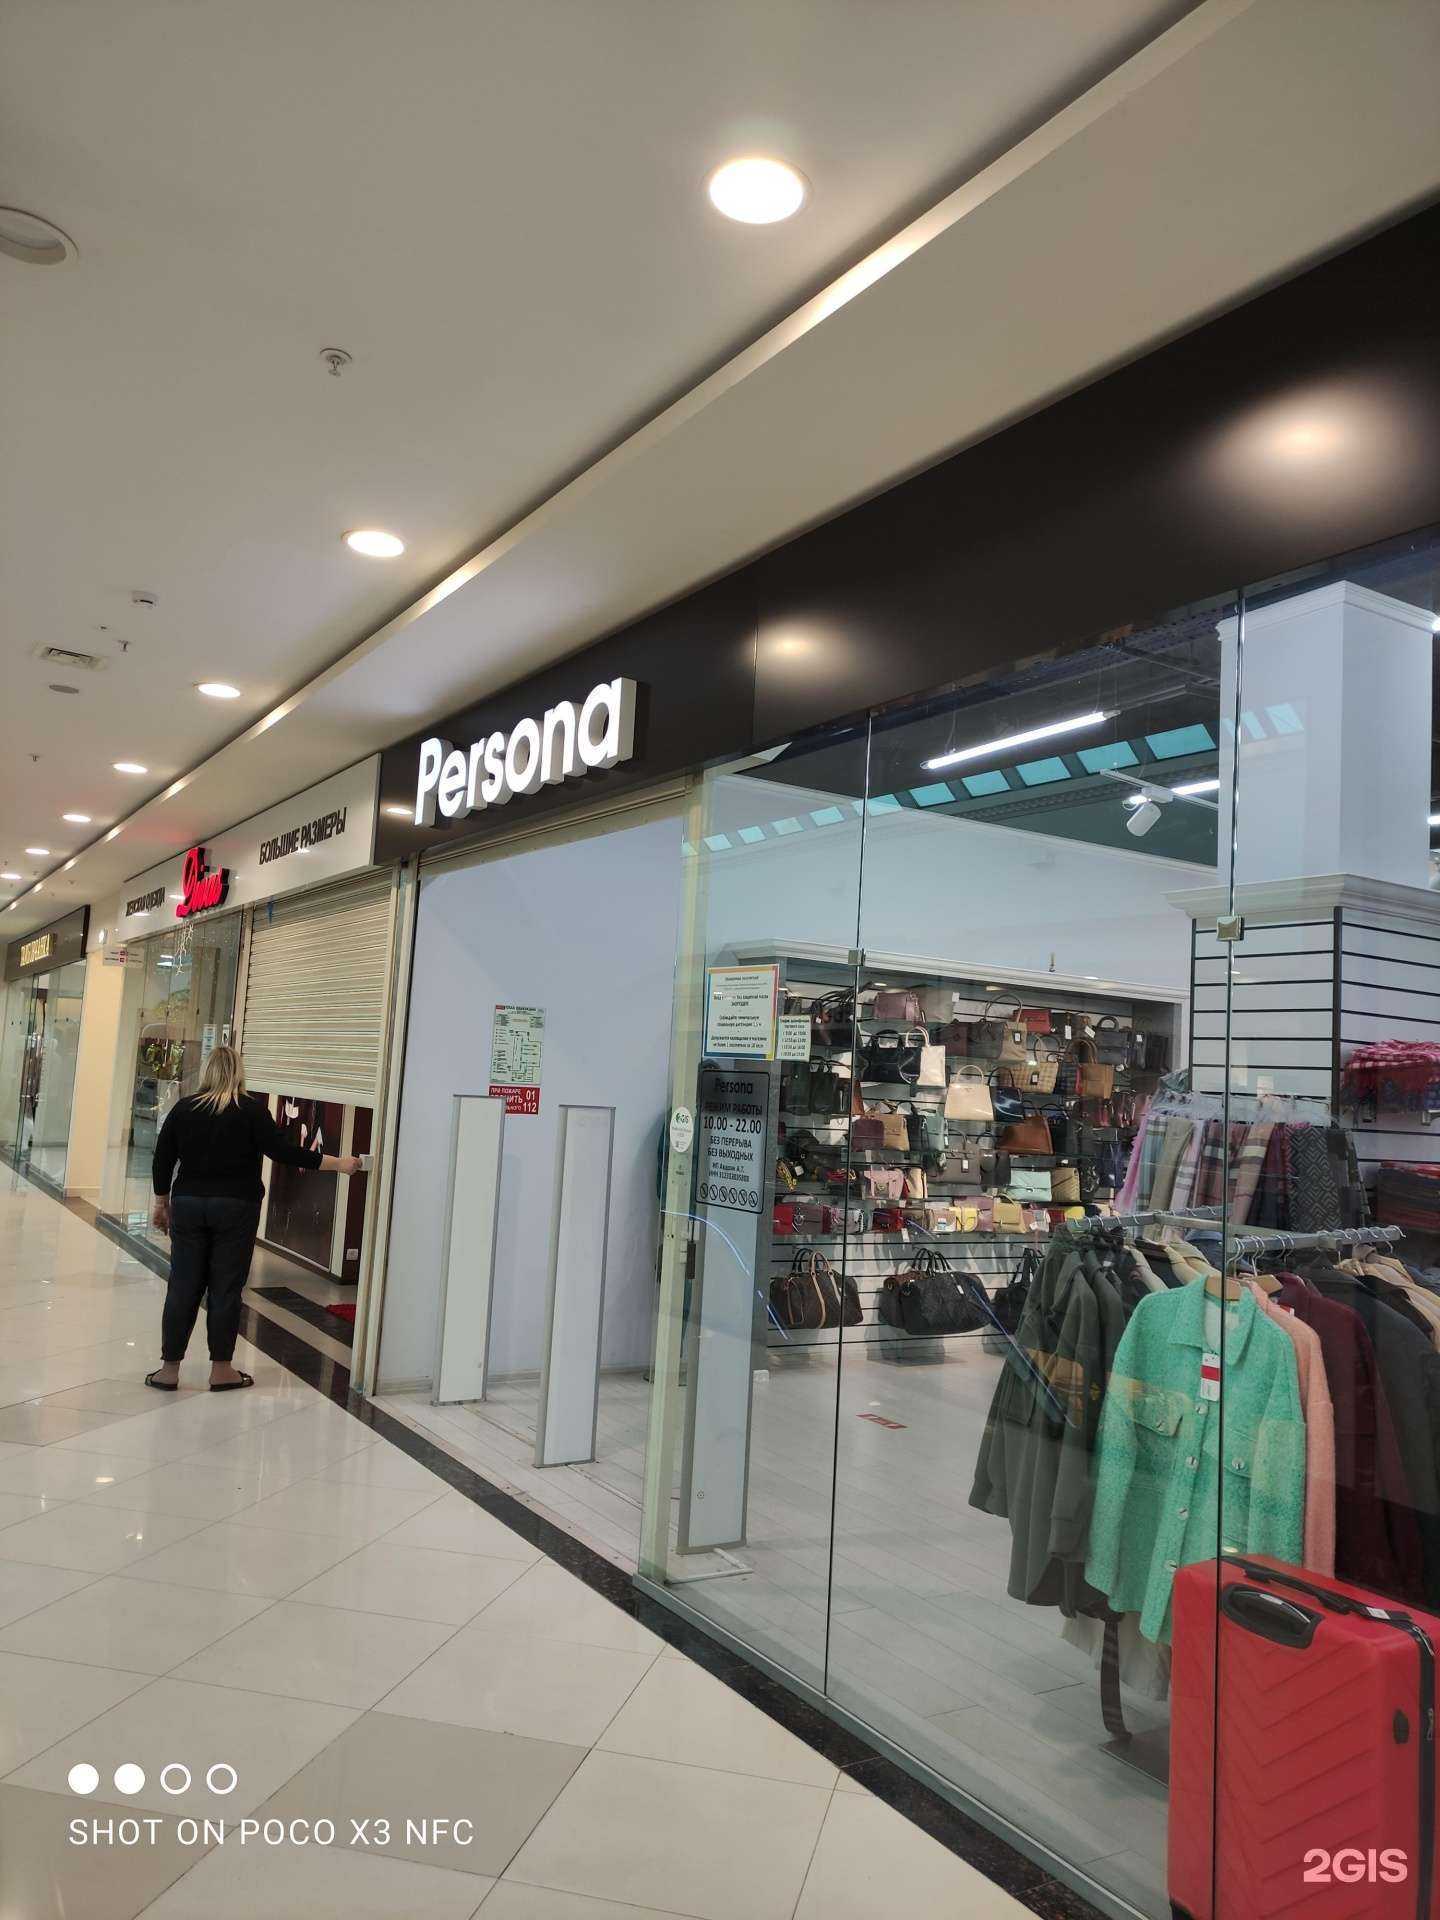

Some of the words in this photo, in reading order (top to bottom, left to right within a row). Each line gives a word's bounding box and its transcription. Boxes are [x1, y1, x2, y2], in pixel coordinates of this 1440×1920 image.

[414, 677, 637, 827] Persona
[259, 828, 301, 865] БОЛЬШИЕ
[299, 807, 347, 849] РАЗМЕРЫ
[714, 1077, 754, 1095] Persona
[525, 1089, 536, 1101] 01
[522, 1101, 537, 1113] 112
[703, 1115, 728, 1131] 10.00
[735, 1118, 762, 1134] 22.00
[710, 1135, 721, 1145] БЕЗ
[720, 1136, 752, 1149] ПЕРЕРЫВА
[707, 1147, 718, 1157] БЕЗ
[718, 1148, 754, 1161] ВЫХОДНЫХ
